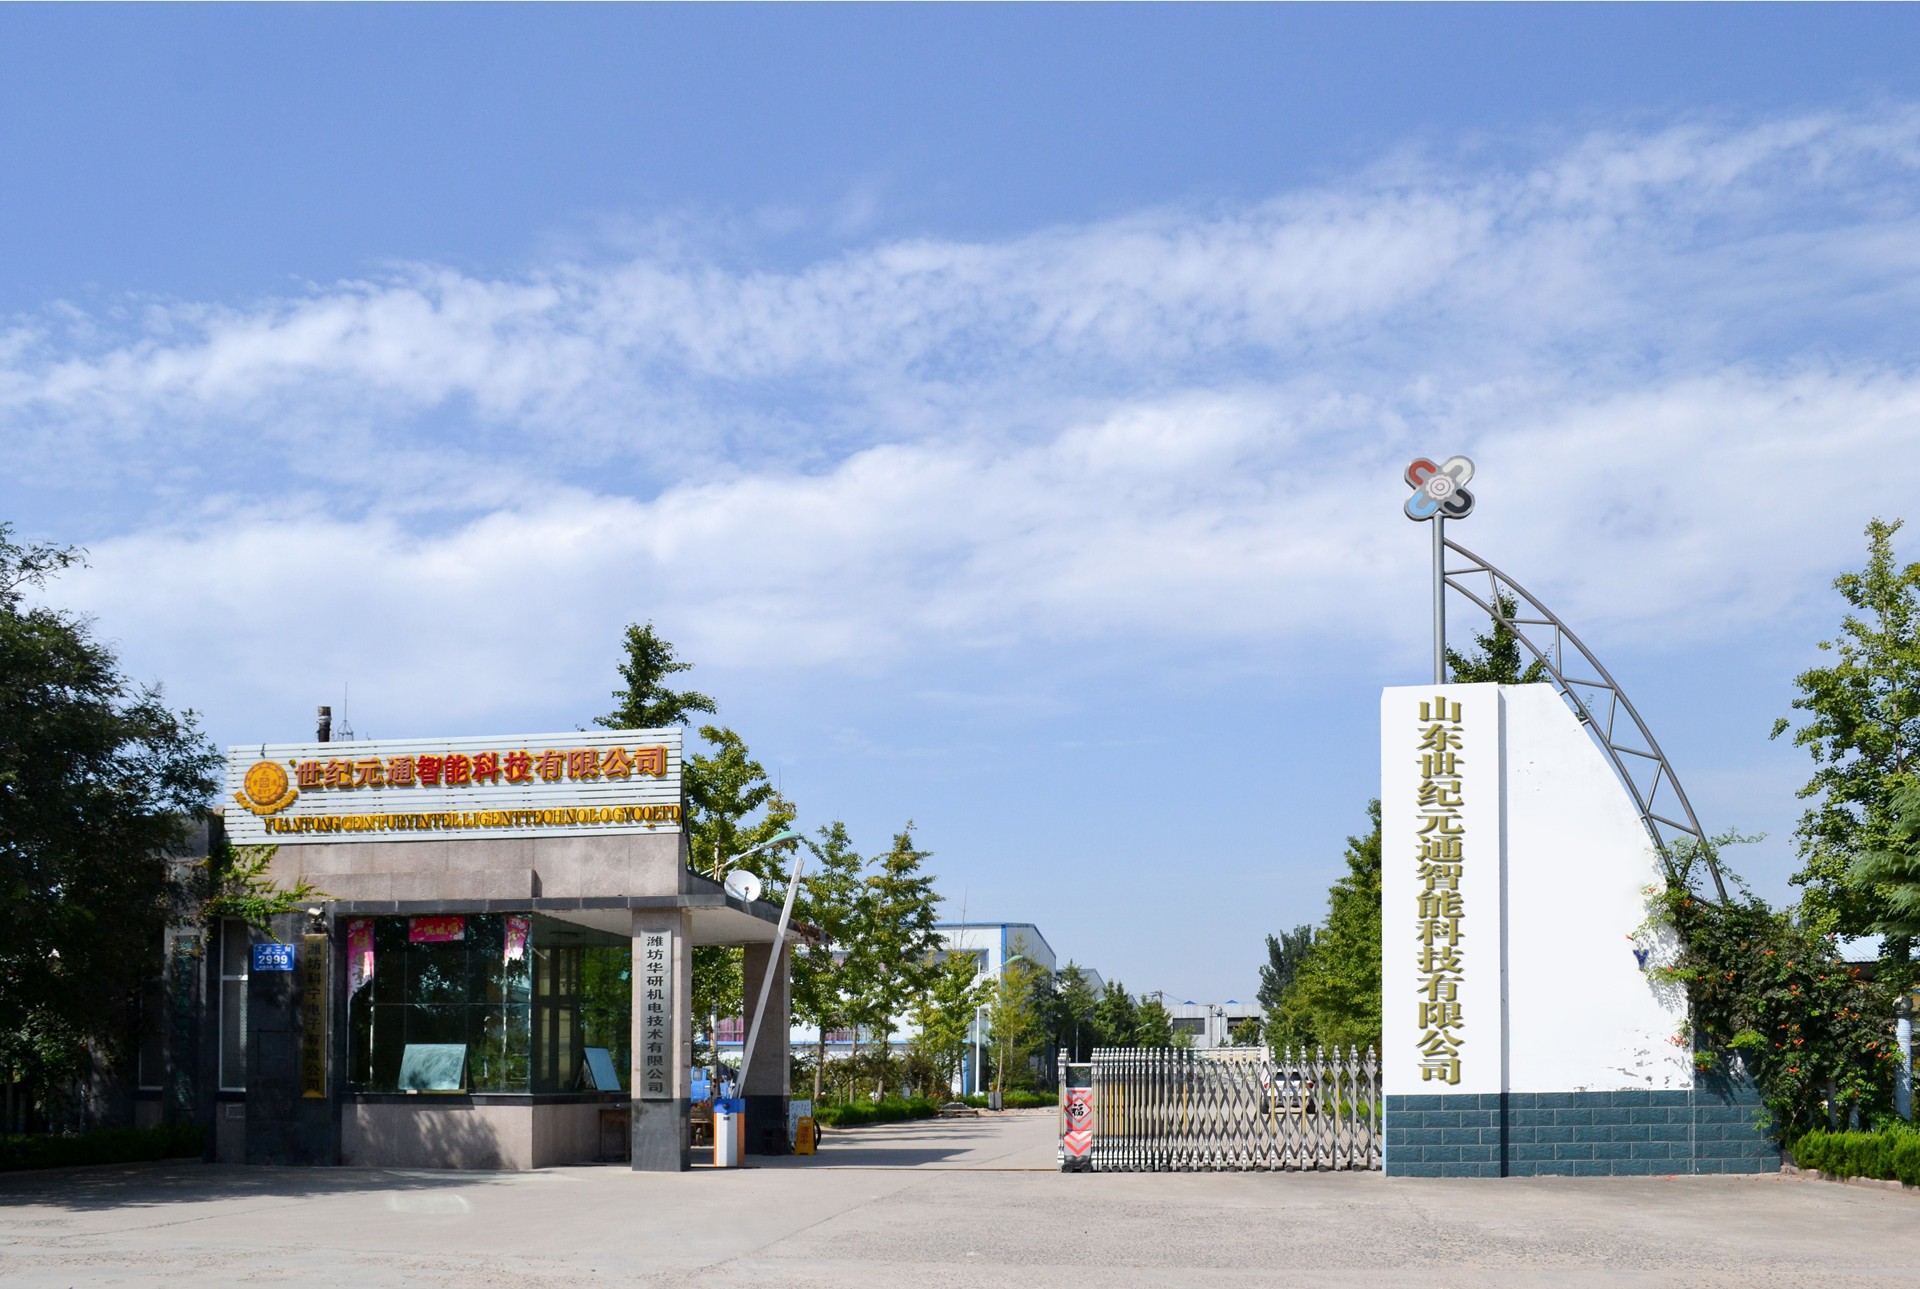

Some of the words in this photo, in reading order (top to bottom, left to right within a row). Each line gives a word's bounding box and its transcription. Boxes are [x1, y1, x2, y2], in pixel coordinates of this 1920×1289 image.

[295, 745, 667, 789] 世纪元通智能科技有限公司
[1415, 696, 1466, 1085] 山东世纪元通智能科技有限公司
[258, 955, 288, 965] 2999
[646, 936, 664, 1093] 潍坊华研机电技术有限公司
